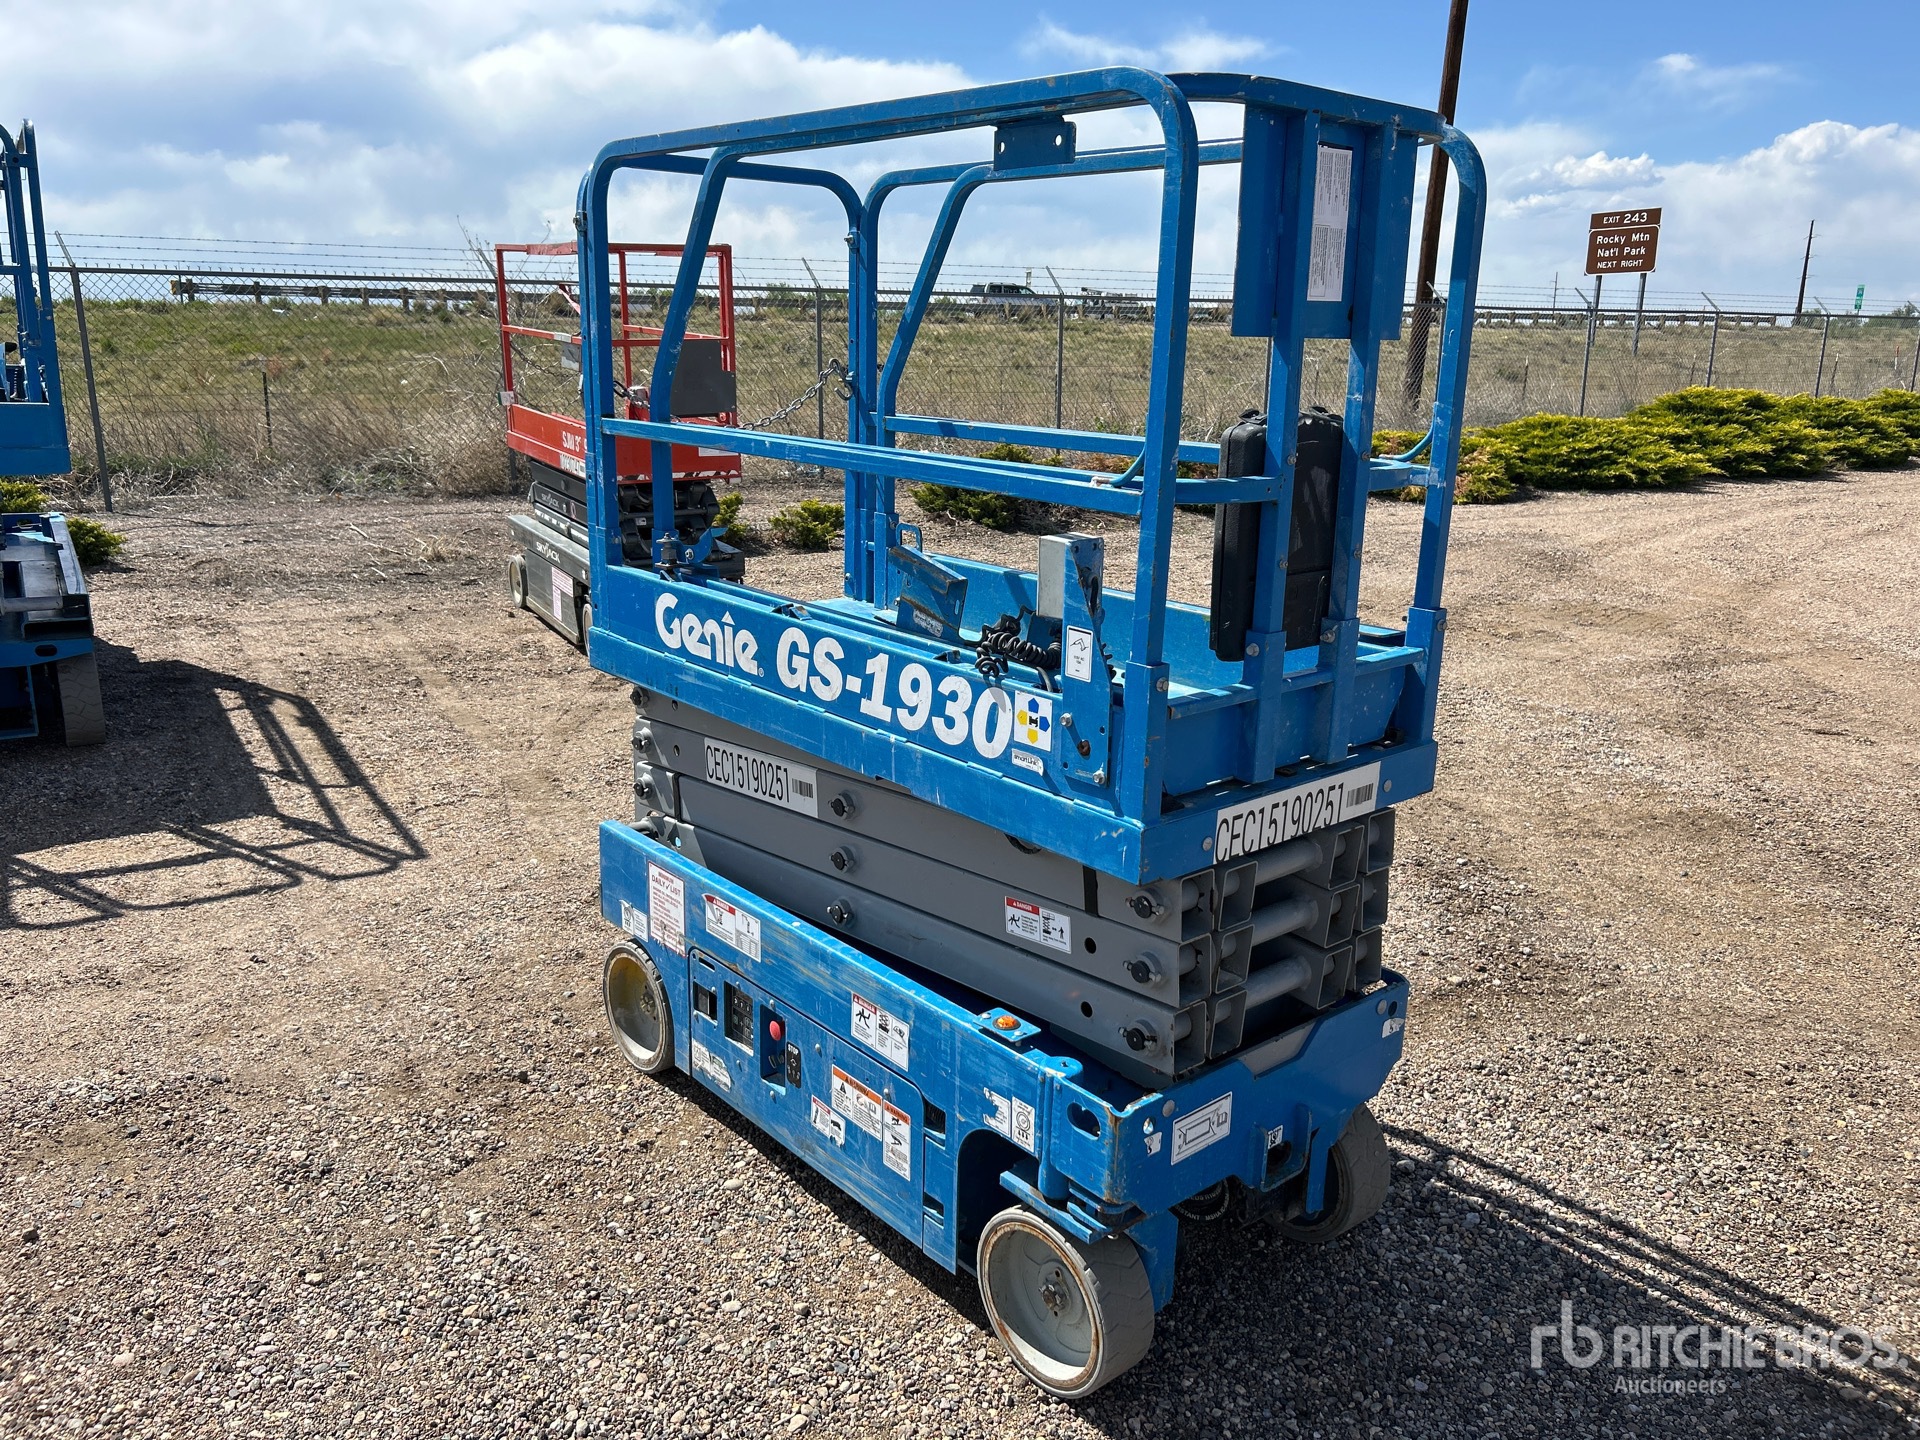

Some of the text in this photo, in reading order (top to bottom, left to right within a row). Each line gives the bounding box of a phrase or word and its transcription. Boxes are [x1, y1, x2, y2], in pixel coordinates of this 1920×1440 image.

[1603, 212, 1648, 224] EXIT 243
[1596, 232, 1650, 245] Rocky Mtn
[1597, 246, 1646, 257] Nat'l Park
[1597, 259, 1643, 269] NEXT RIGHT
[655, 592, 758, 676] Genie
[776, 627, 1012, 759] GS-1930
[704, 743, 791, 804] CEC15190251
[1215, 782, 1344, 863] CEC15190251
[787, 1044, 799, 1056] STOP
